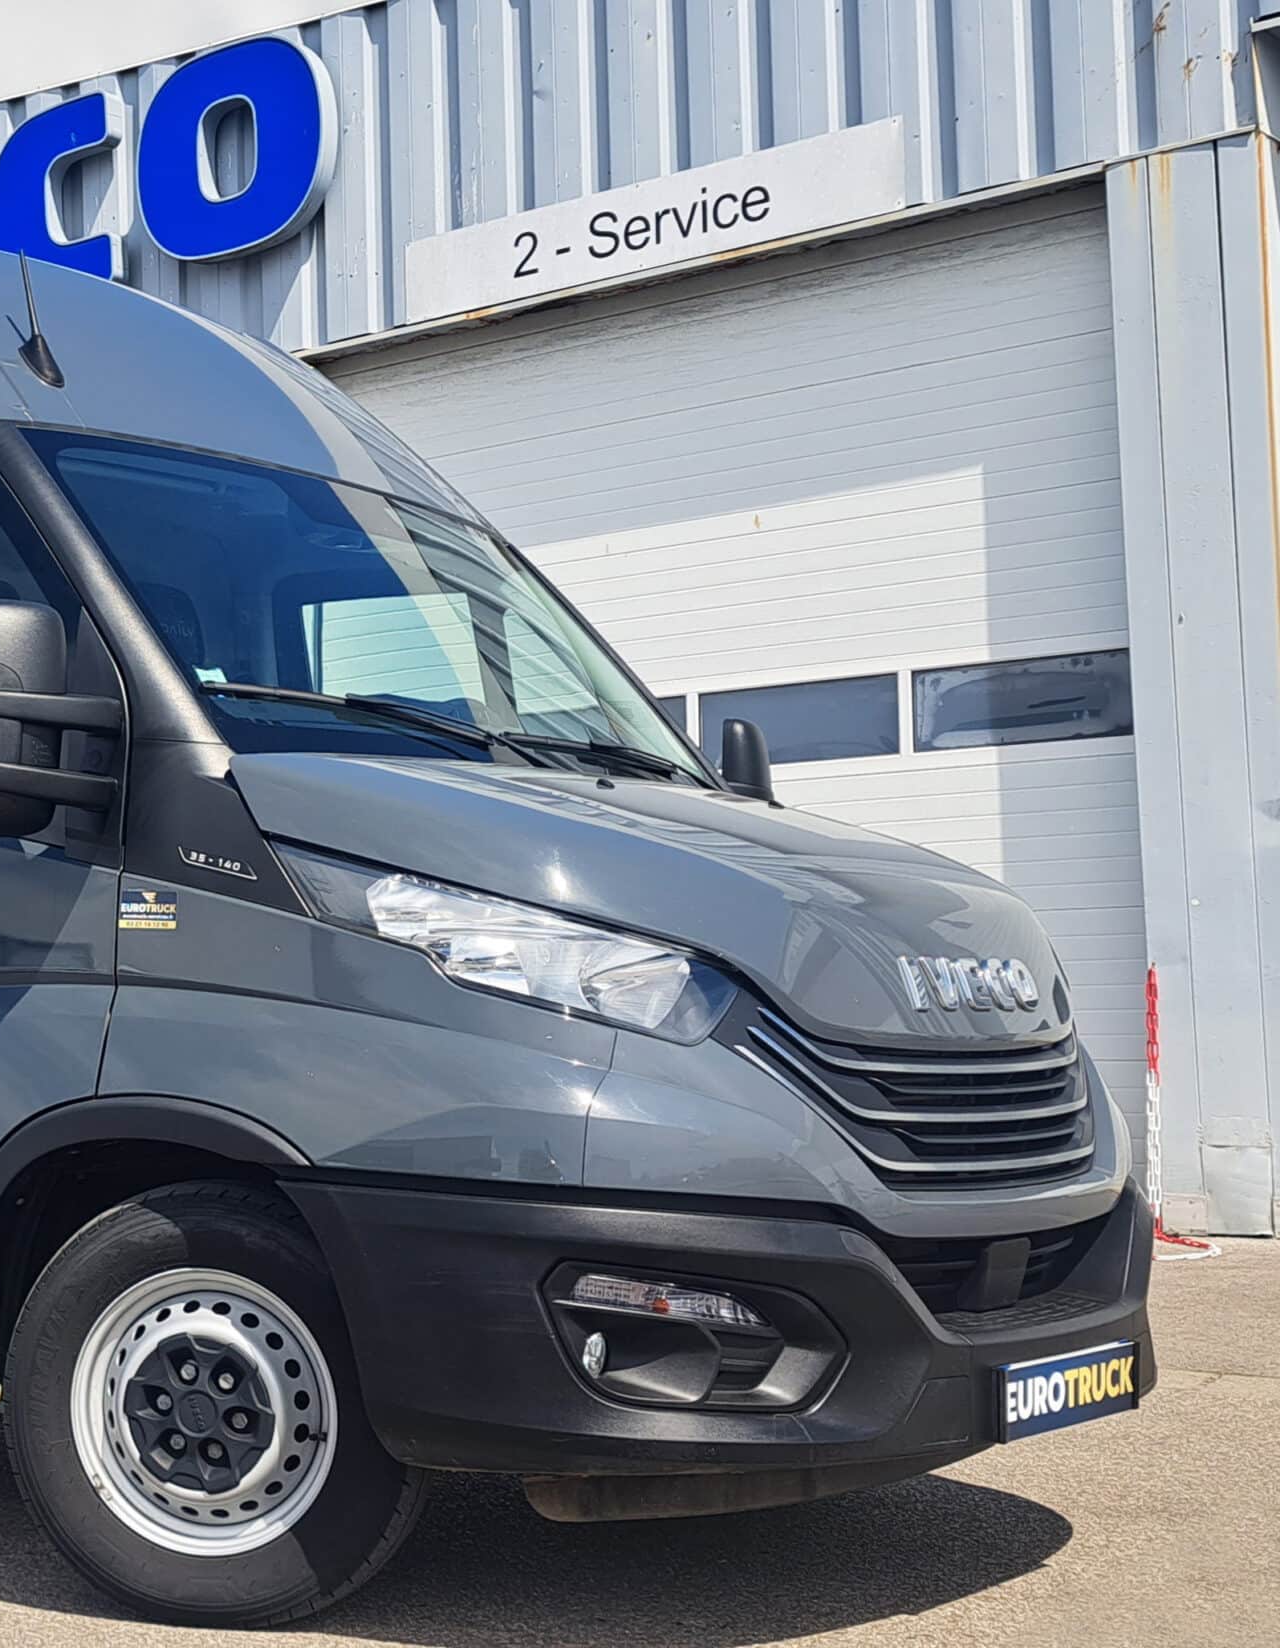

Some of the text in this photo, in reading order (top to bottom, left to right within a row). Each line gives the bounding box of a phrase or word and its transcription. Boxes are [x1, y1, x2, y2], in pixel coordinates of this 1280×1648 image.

[511, 183, 771, 279] 2 - Service
[189, 850, 207, 863] 35
[218, 857, 242, 871] 140
[121, 902, 177, 914] EUROTRUCK
[896, 955, 1041, 1013] IVECO
[1007, 1355, 1135, 1424] EUROTRUCK
